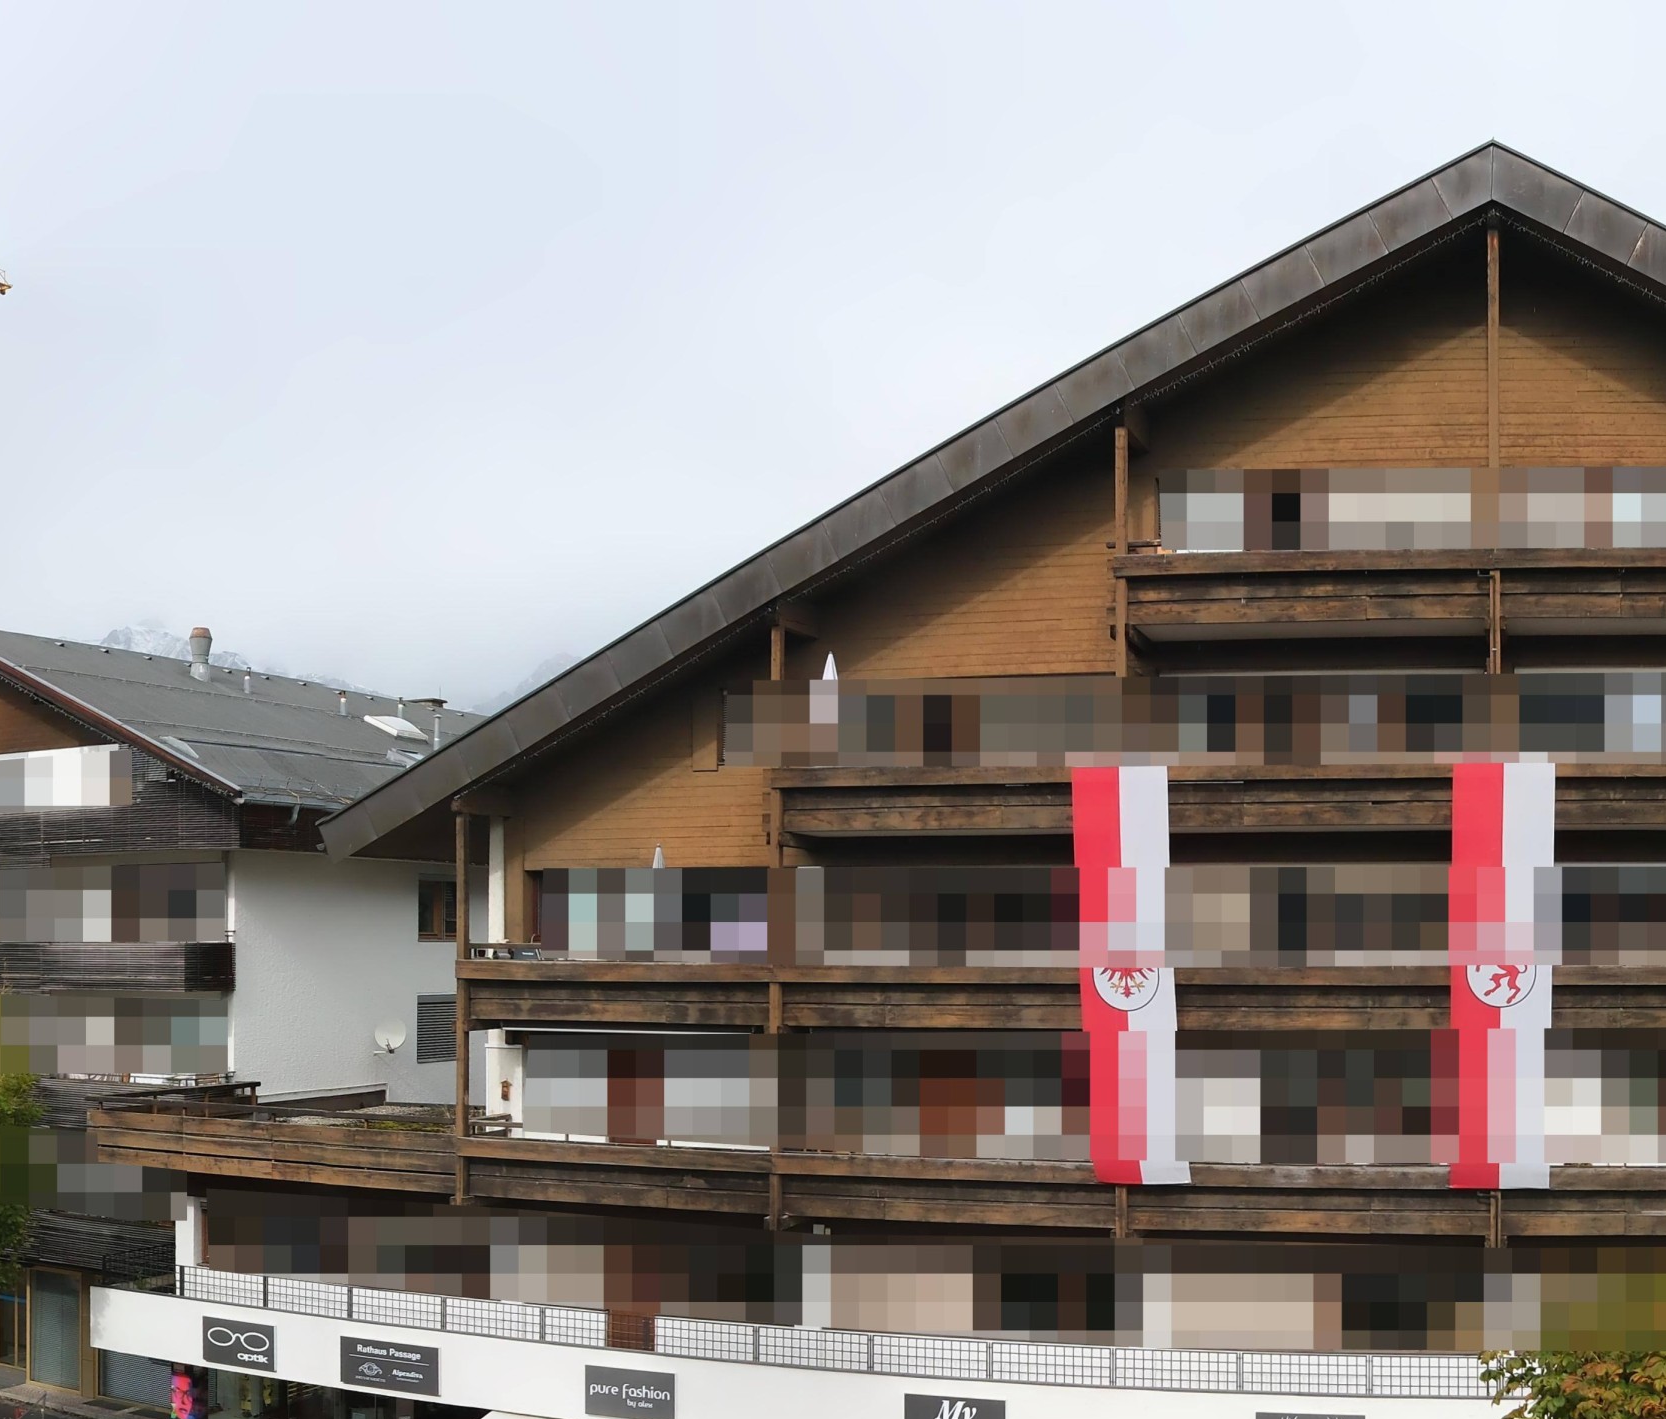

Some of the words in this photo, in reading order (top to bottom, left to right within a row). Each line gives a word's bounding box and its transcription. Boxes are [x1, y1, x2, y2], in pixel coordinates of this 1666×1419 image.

[237, 1352, 269, 1364] optik
[389, 1347, 421, 1361] Passage
[589, 1383, 619, 1396] pure
[626, 1399, 636, 1408] by
[638, 1401, 653, 1409] alex
